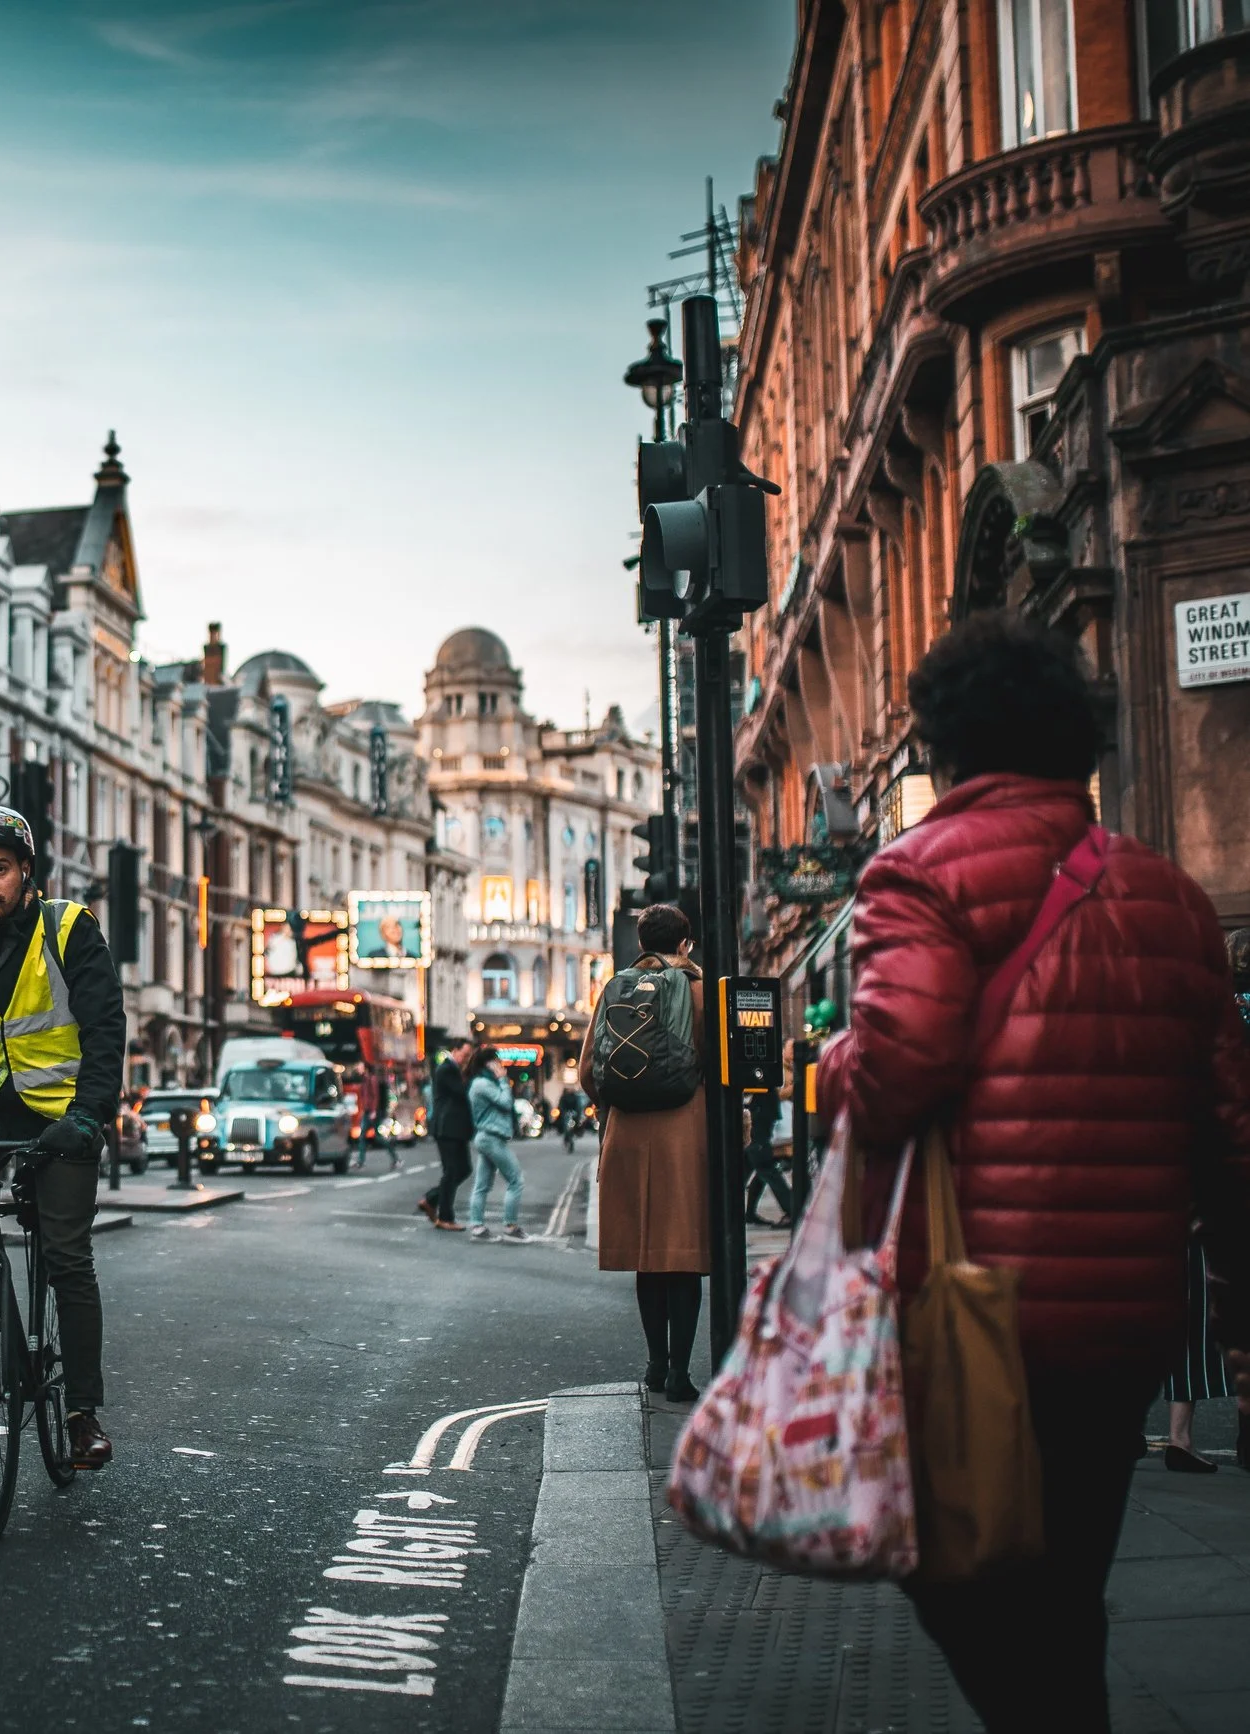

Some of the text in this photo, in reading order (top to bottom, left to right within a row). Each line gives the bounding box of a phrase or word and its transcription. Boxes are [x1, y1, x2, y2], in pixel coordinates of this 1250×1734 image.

[1187, 601, 1240, 624] GREAT
[1189, 640, 1249, 664] STREET
[738, 1011, 771, 1027] WAIT
[282, 1509, 479, 1696] LOOK RIGHT
